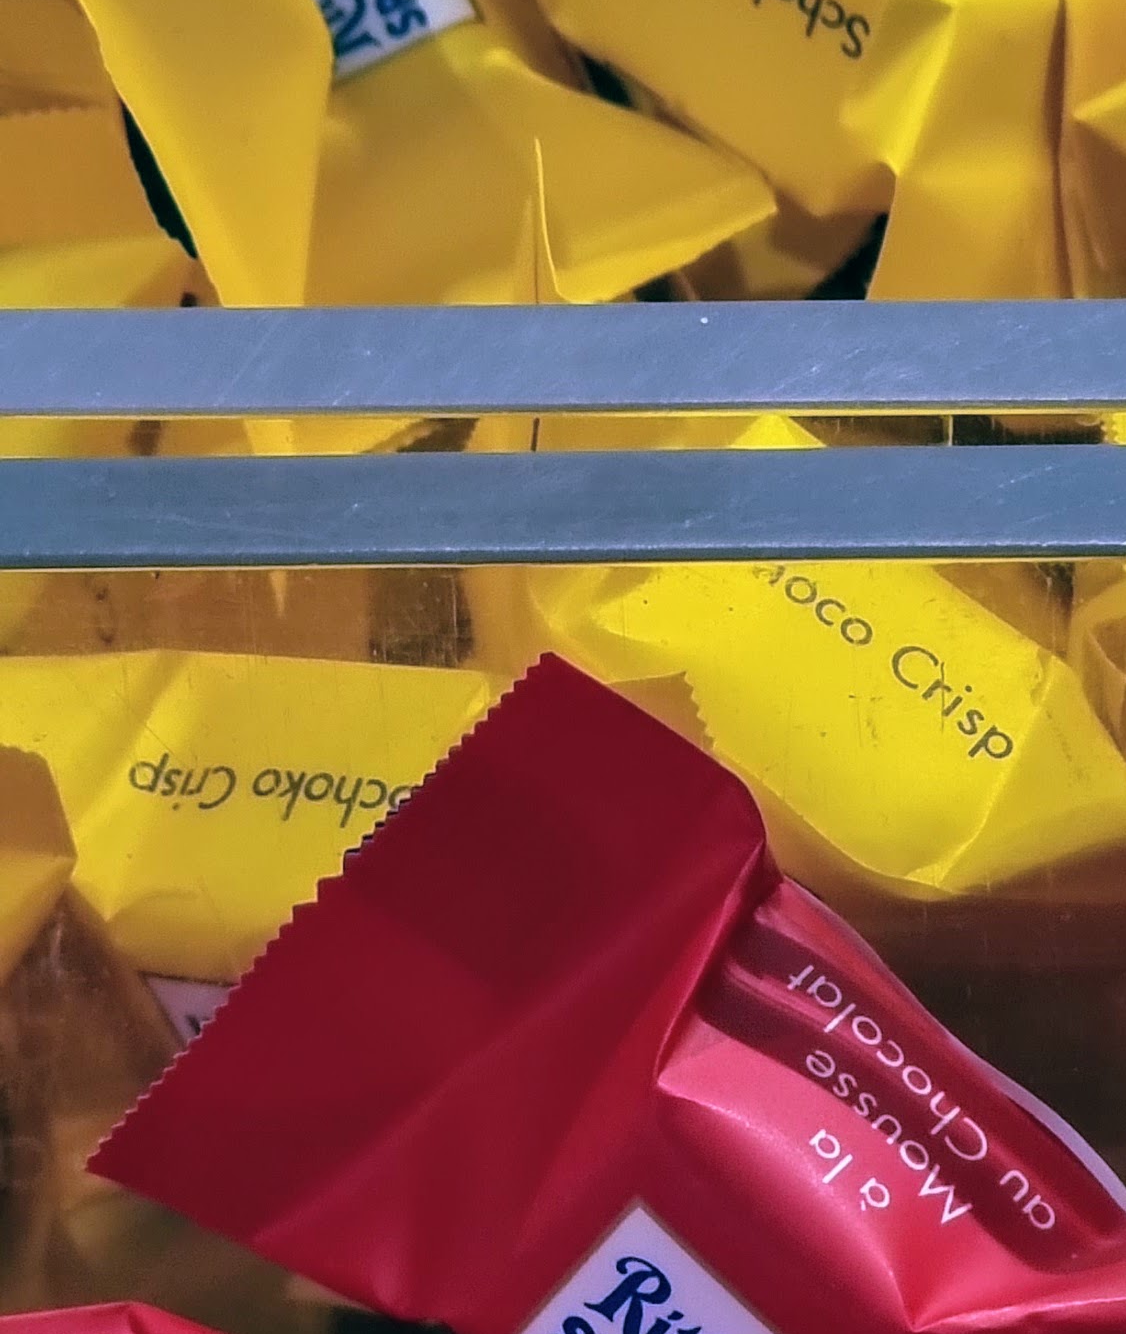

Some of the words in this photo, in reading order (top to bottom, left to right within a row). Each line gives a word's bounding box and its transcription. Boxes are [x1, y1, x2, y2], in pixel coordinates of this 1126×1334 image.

[890, 643, 1014, 760] Crisp
[128, 752, 236, 811] Crisp
[788, 965, 988, 1160] Chocolat
[806, 1050, 973, 1224] Mousse
[809, 1129, 853, 1184] la
[1000, 1170, 1055, 1229] au
